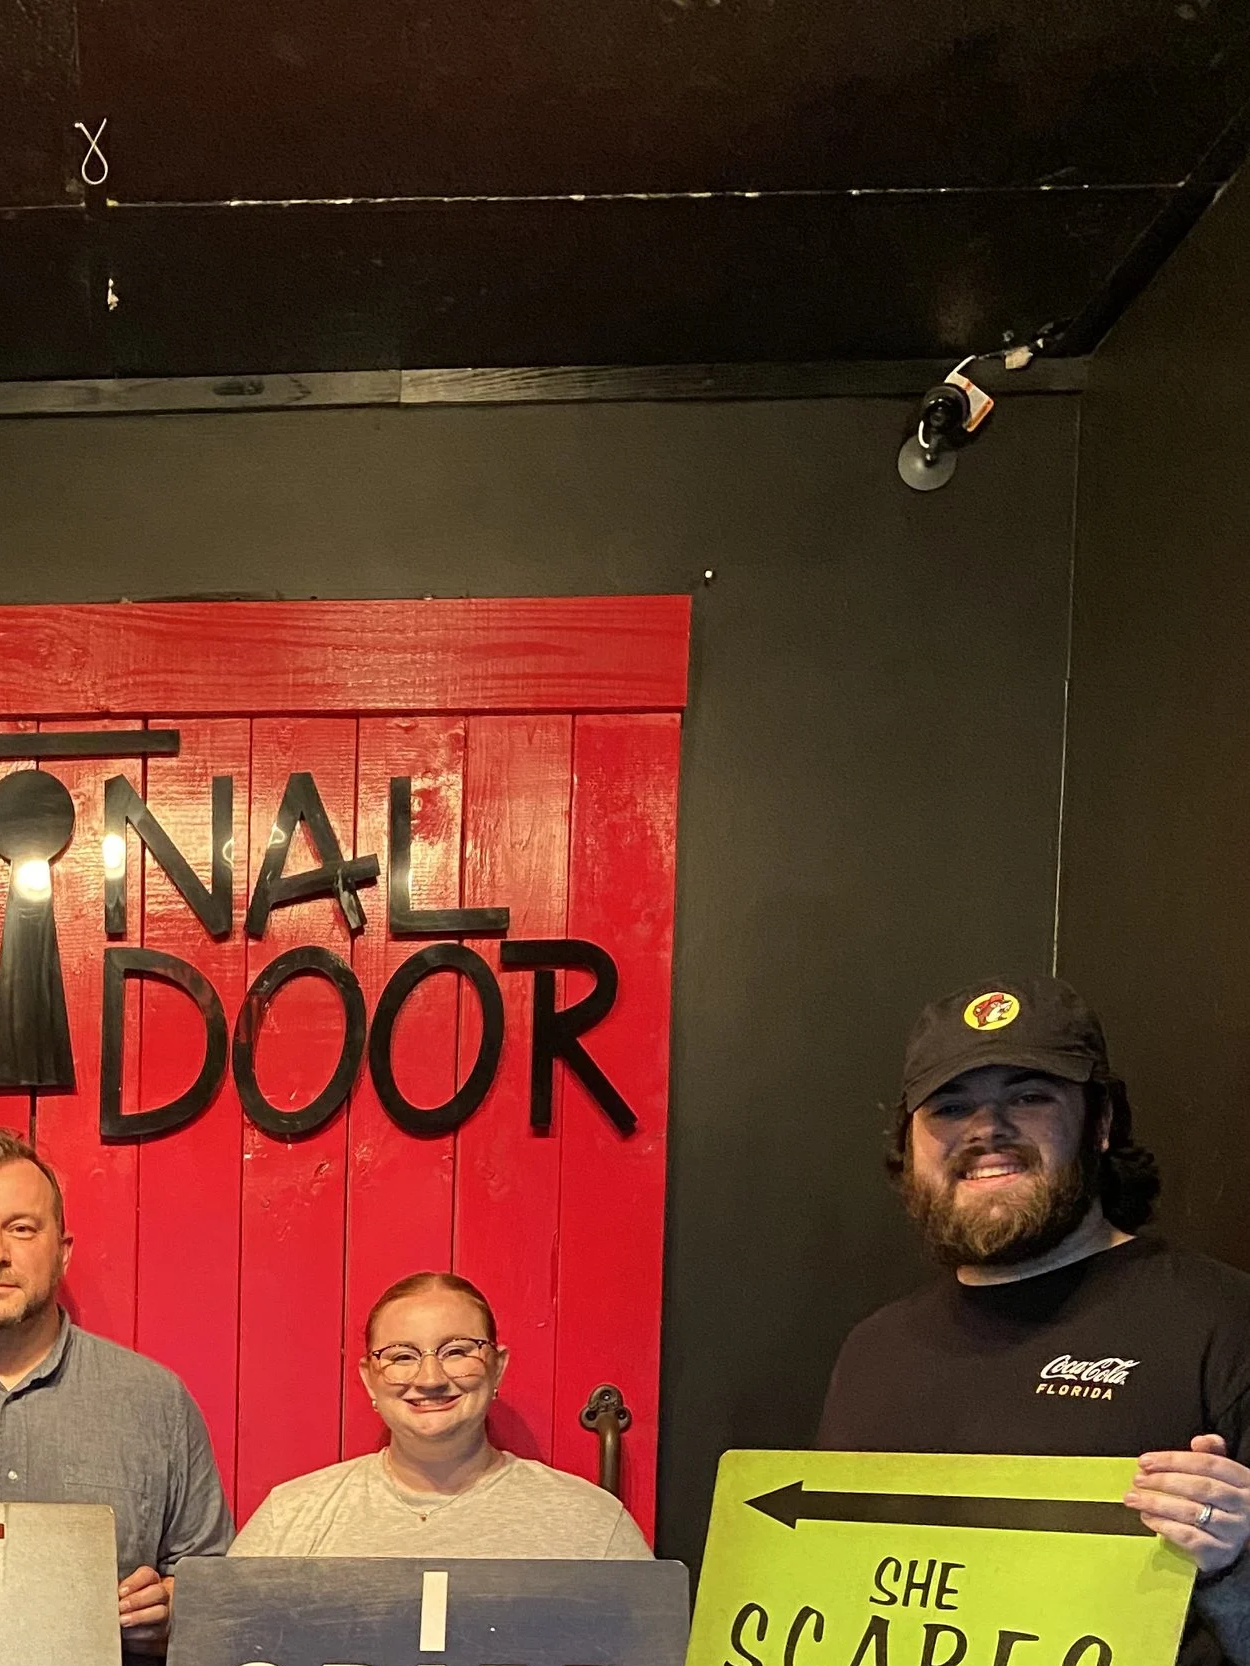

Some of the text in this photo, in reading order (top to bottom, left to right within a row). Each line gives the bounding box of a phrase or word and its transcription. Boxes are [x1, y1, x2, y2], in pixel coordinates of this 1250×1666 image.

[98, 939, 638, 1146] DOOR
[1035, 1383, 1113, 1401] FLORIDA
[418, 1570, 450, 1653] I
[868, 1555, 967, 1612] SHE
